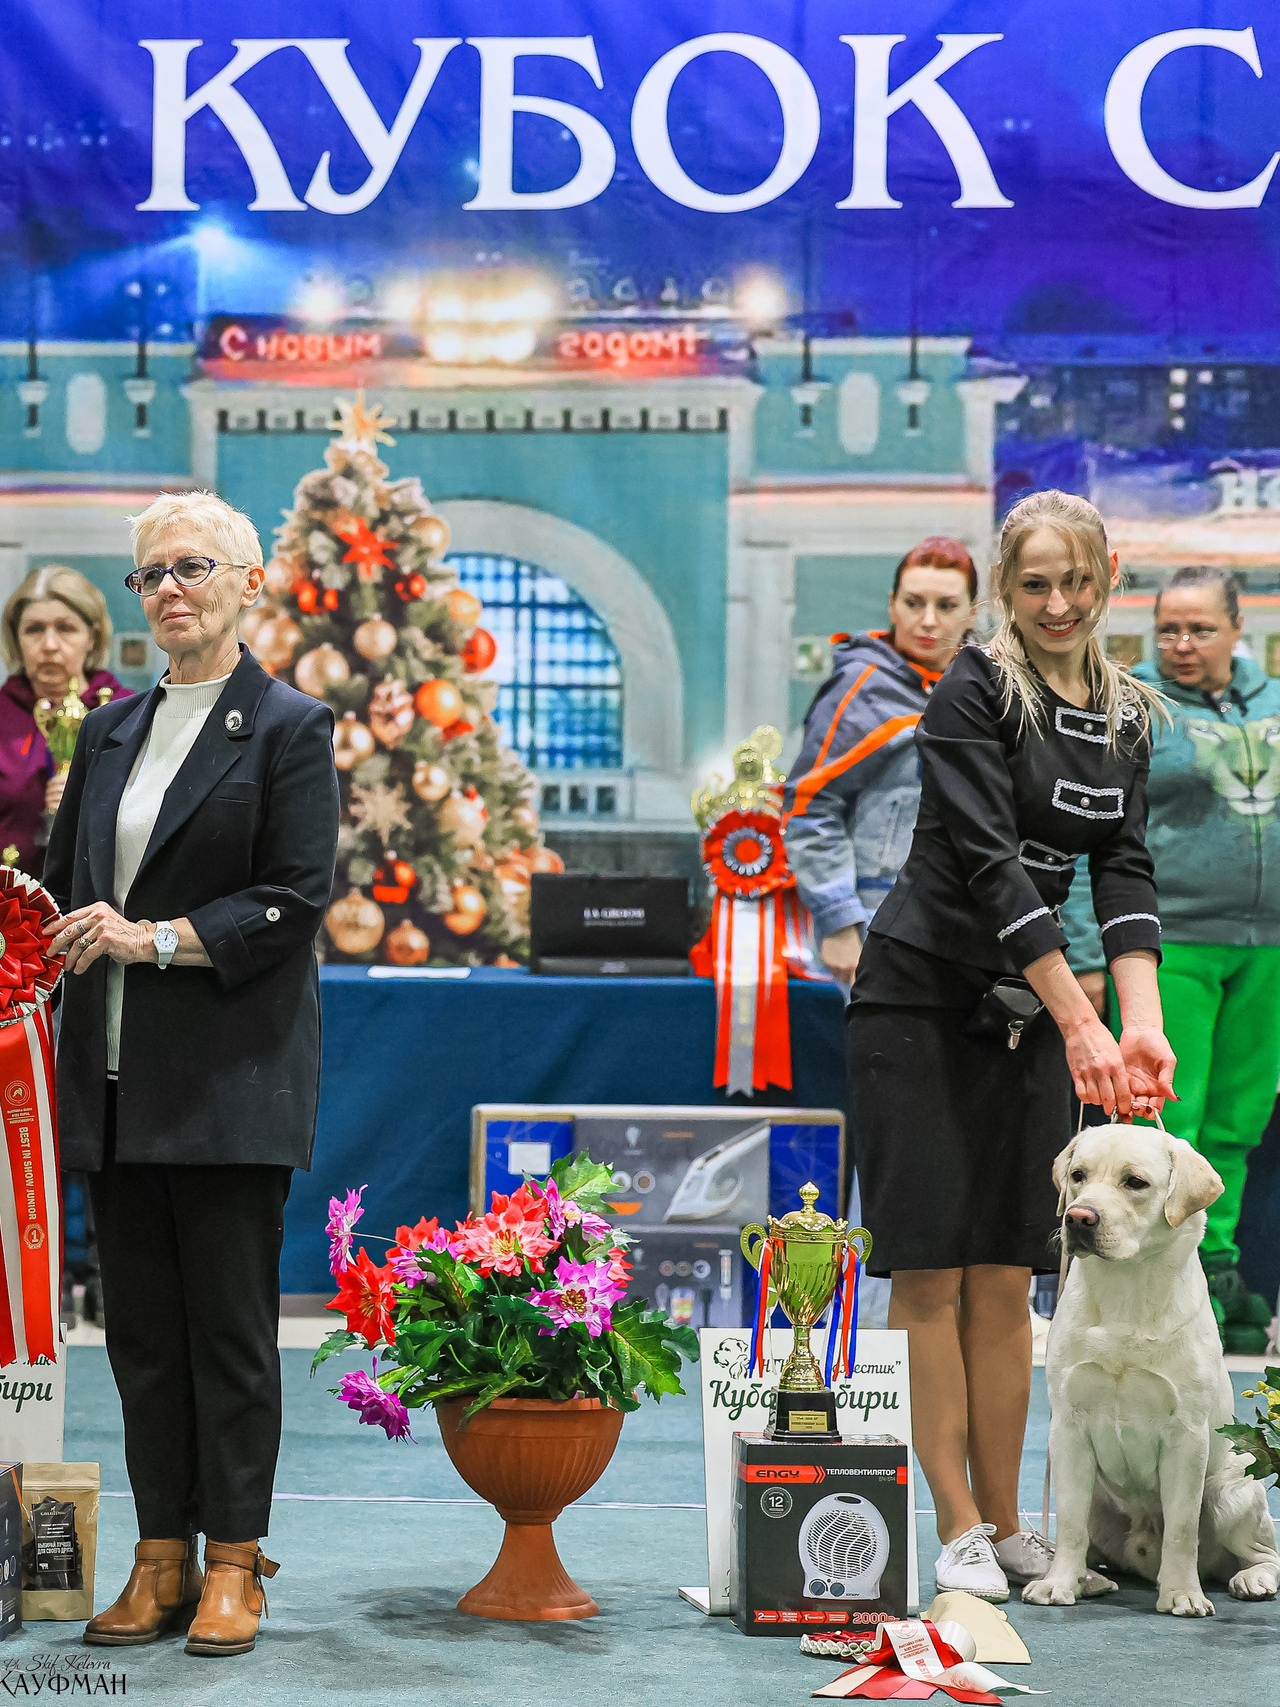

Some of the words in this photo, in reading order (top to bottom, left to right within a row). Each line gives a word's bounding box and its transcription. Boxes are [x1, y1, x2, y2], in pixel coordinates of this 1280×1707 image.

[136, 32, 1015, 214] КУБОК
[19, 1126, 31, 1148] BEST
[22, 1149, 32, 1159] IN
[23, 1160, 35, 1187] SHOW
[26, 1189, 37, 1220] JUNIOR
[31, 1229, 39, 1243] 1
[756, 1470, 800, 1479] ENGY
[825, 1468, 896, 1477] ТЕПЛОВЕНТИЛЯТОР
[768, 1496, 784, 1508] 12
[915, 1658, 930, 1676] BEST
